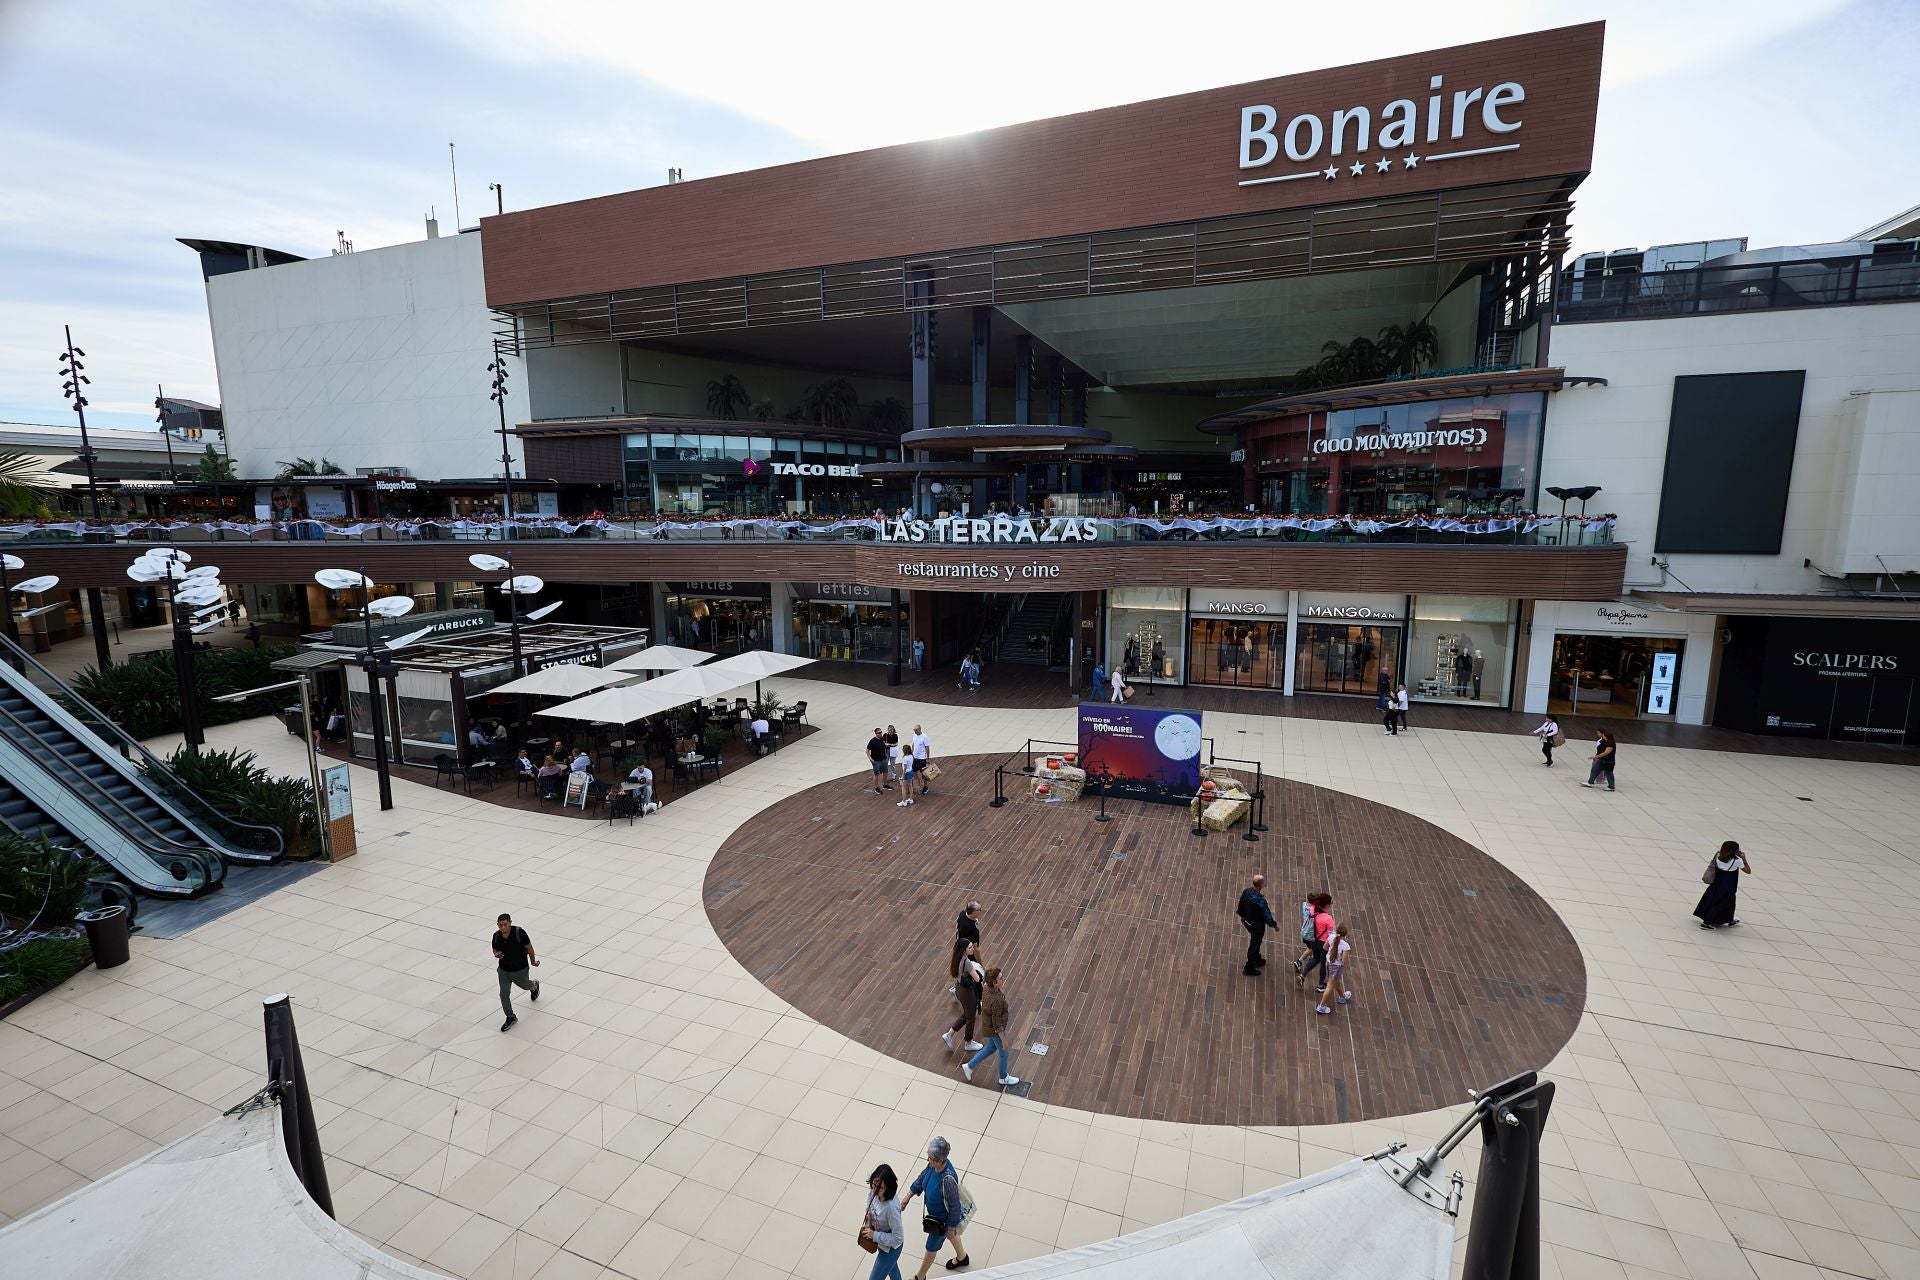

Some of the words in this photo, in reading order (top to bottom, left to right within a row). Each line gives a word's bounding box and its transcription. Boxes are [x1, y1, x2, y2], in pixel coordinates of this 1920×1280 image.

[1239, 74, 1526, 170] Bonaire
[769, 462, 826, 476] TACO
[827, 463, 864, 478] BEL
[375, 480, 417, 492] Häagen-Dazs
[880, 518, 926, 542] LAS
[938, 517, 1099, 543] TERRAZAS
[898, 561, 1000, 578] restaurantes
[1004, 563, 1016, 581] y
[1021, 560, 1061, 578] cine
[817, 581, 870, 596] lefties
[1209, 602, 1266, 614] MANGO
[1308, 606, 1371, 618] MANGO
[1597, 607, 1619, 621] Pepe
[1618, 609, 1648, 622] Jeans
[1793, 652, 1898, 670] SCALPERS
